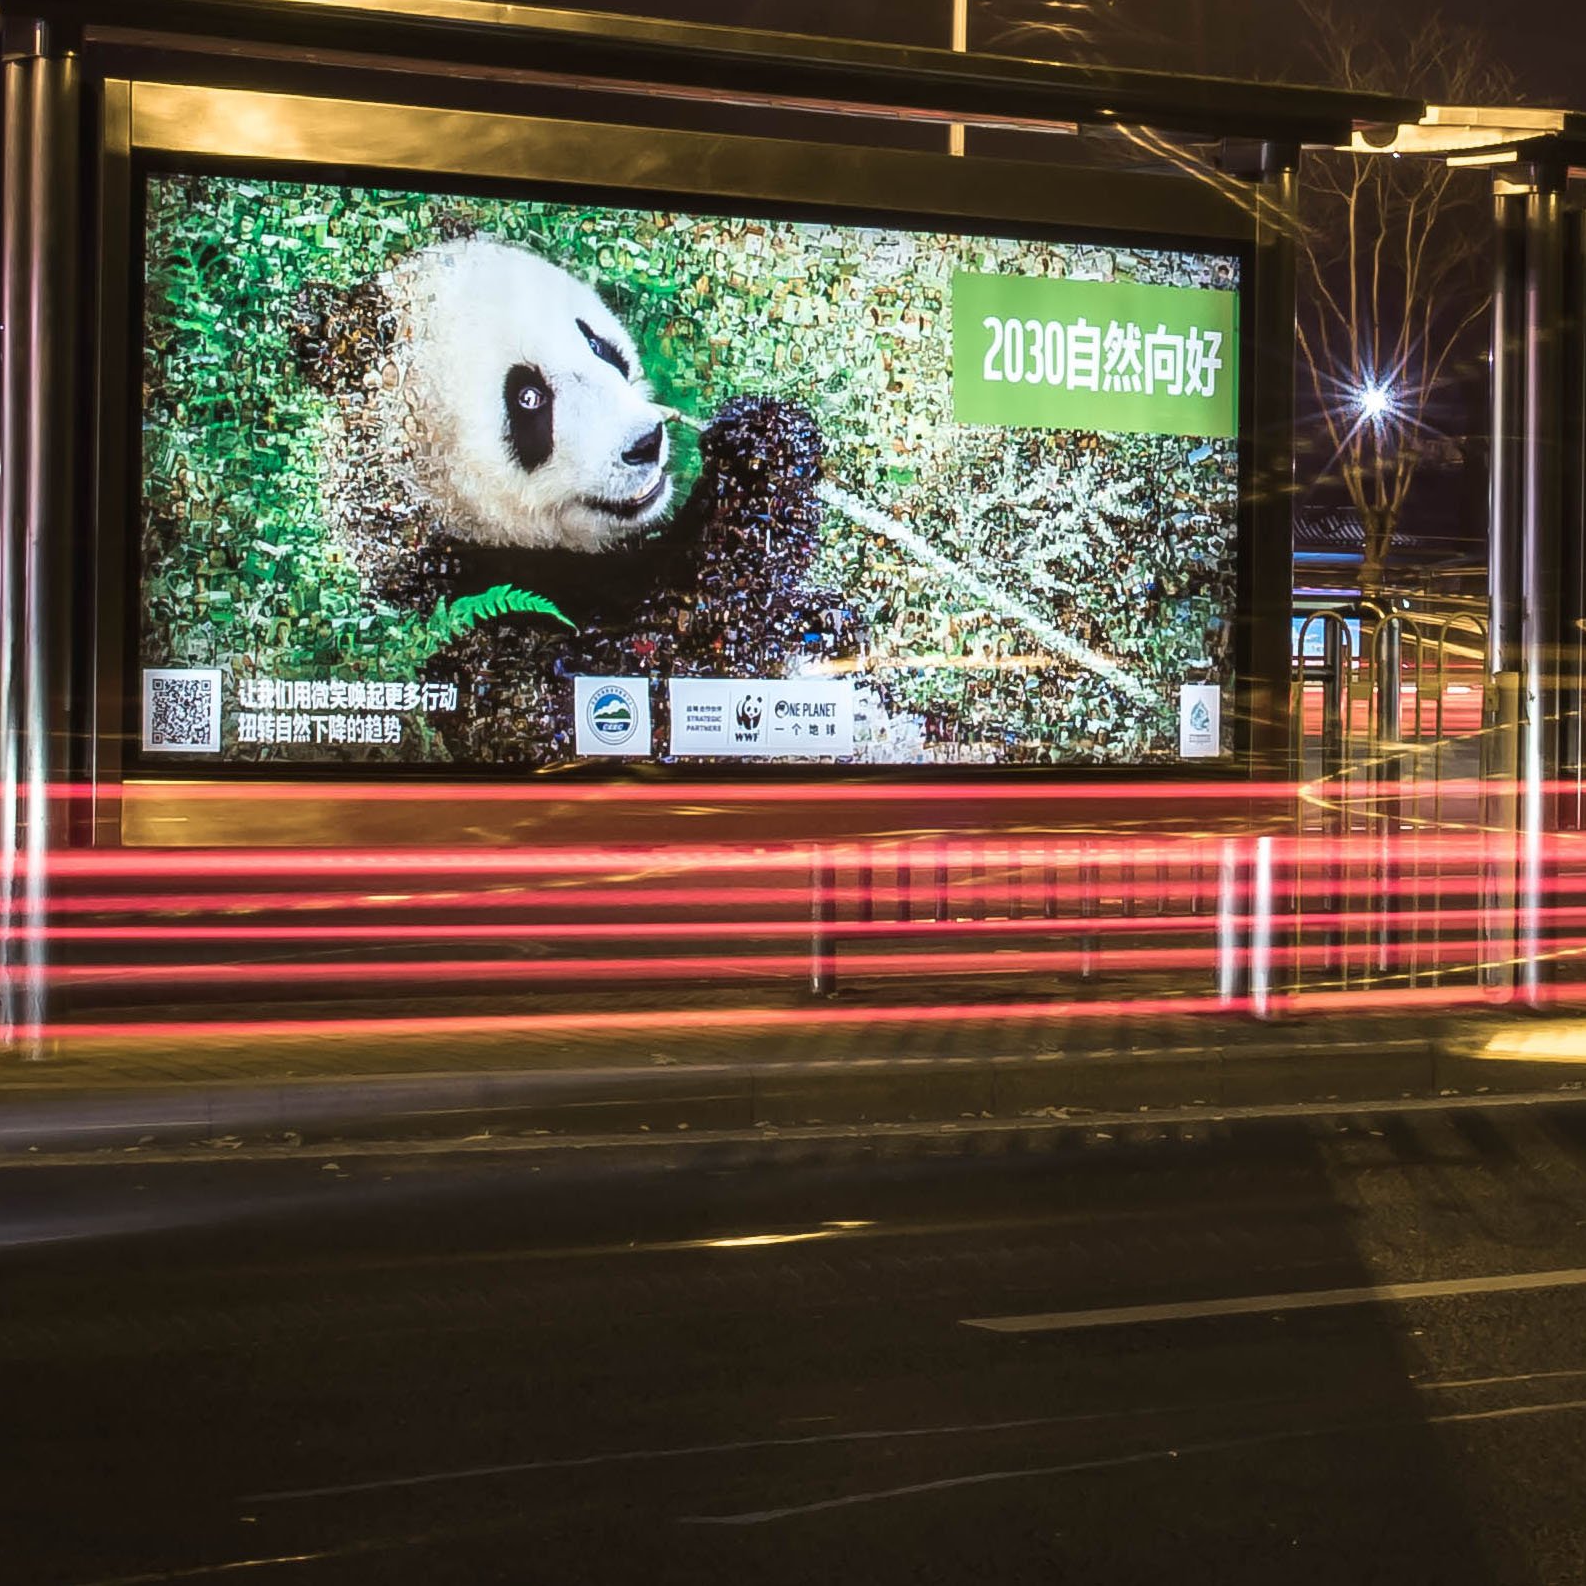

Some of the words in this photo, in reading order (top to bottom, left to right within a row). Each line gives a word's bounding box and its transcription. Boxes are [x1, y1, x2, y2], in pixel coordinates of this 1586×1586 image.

[982, 316, 1223, 398] 2030自然向好
[238, 679, 458, 711] 让我们用微笑唤起更多行动
[802, 702, 837, 718] PLANET
[238, 712, 402, 744] 扭转自然下降的趋势
[735, 732, 759, 742] WWF
